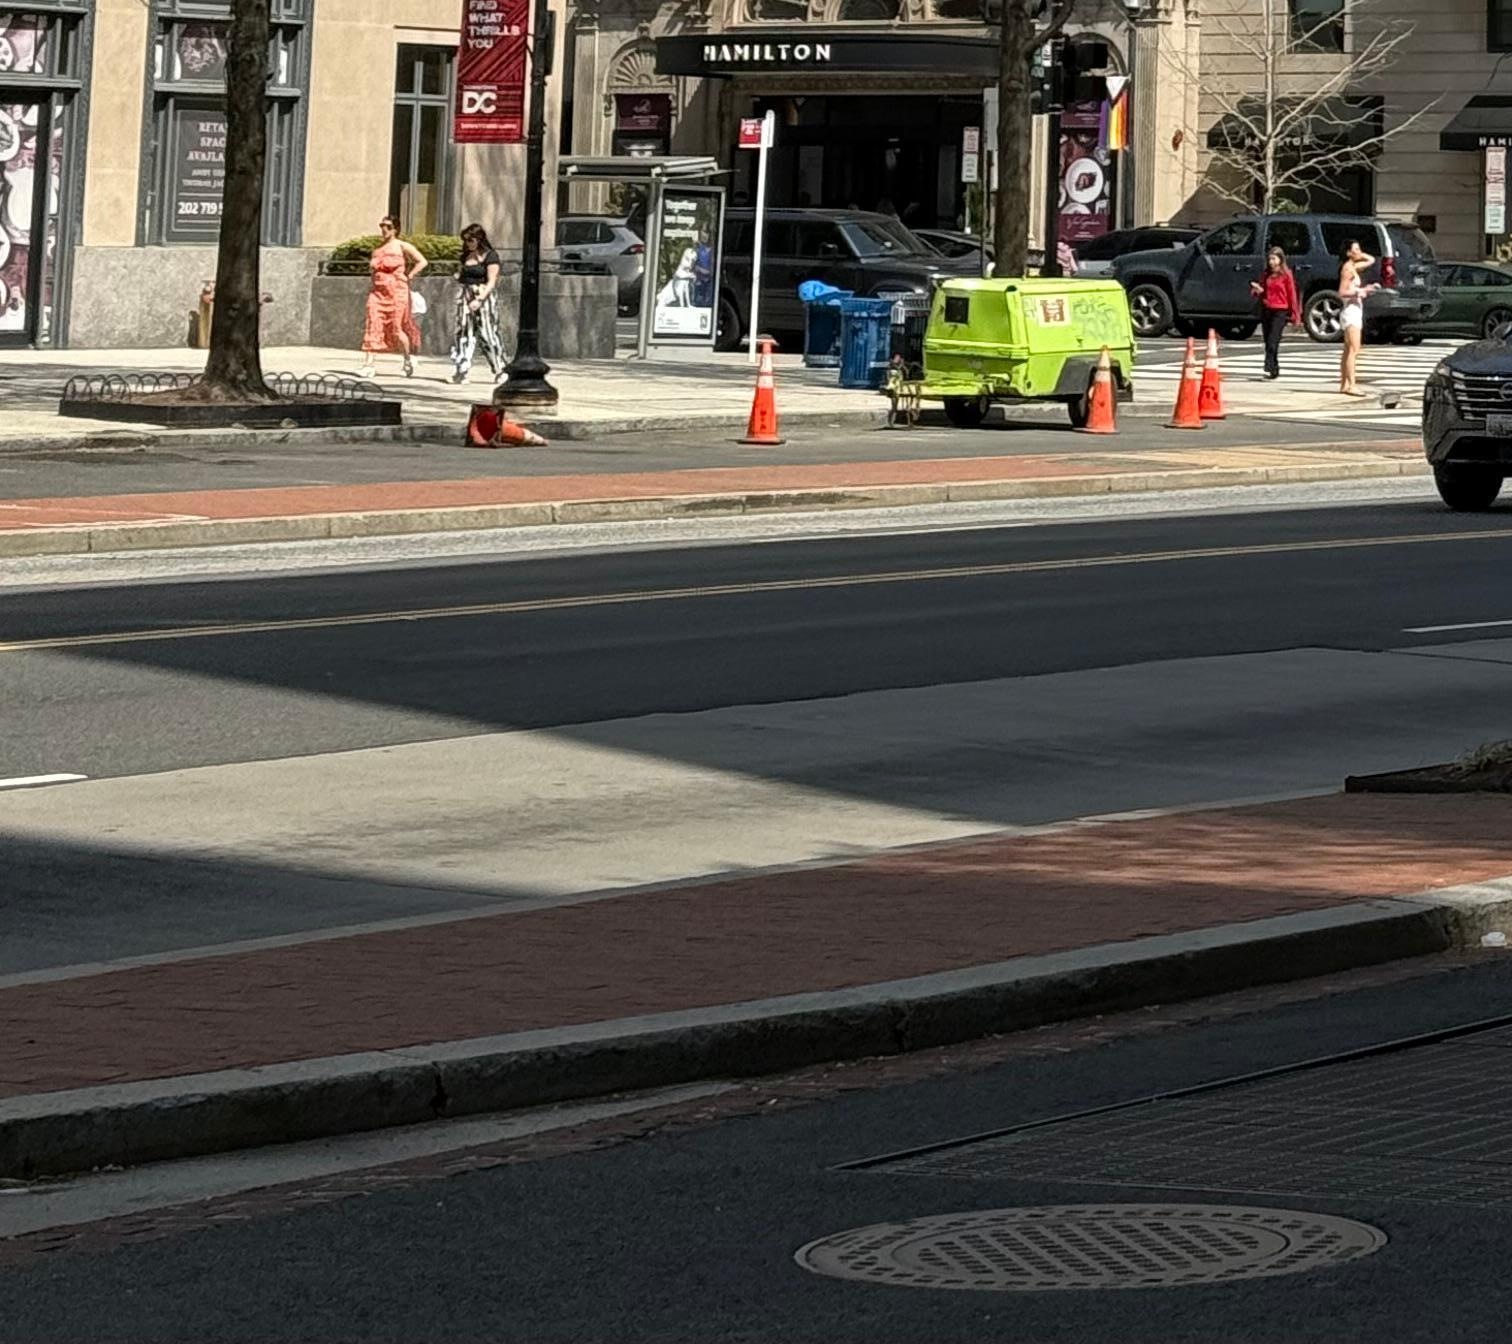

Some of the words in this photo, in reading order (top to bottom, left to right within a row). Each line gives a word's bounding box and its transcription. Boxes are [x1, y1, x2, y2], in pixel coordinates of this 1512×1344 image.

[469, 0, 497, 10] FIND
[469, 13, 505, 23] WHAT
[467, 39, 494, 49] YOU
[703, 44, 831, 62] HAMILTON
[462, 91, 497, 113] DC
[199, 136, 226, 148] SPAC
[187, 150, 225, 162] AVAILA
[177, 201, 199, 215] 202
[200, 201, 218, 215] 719
